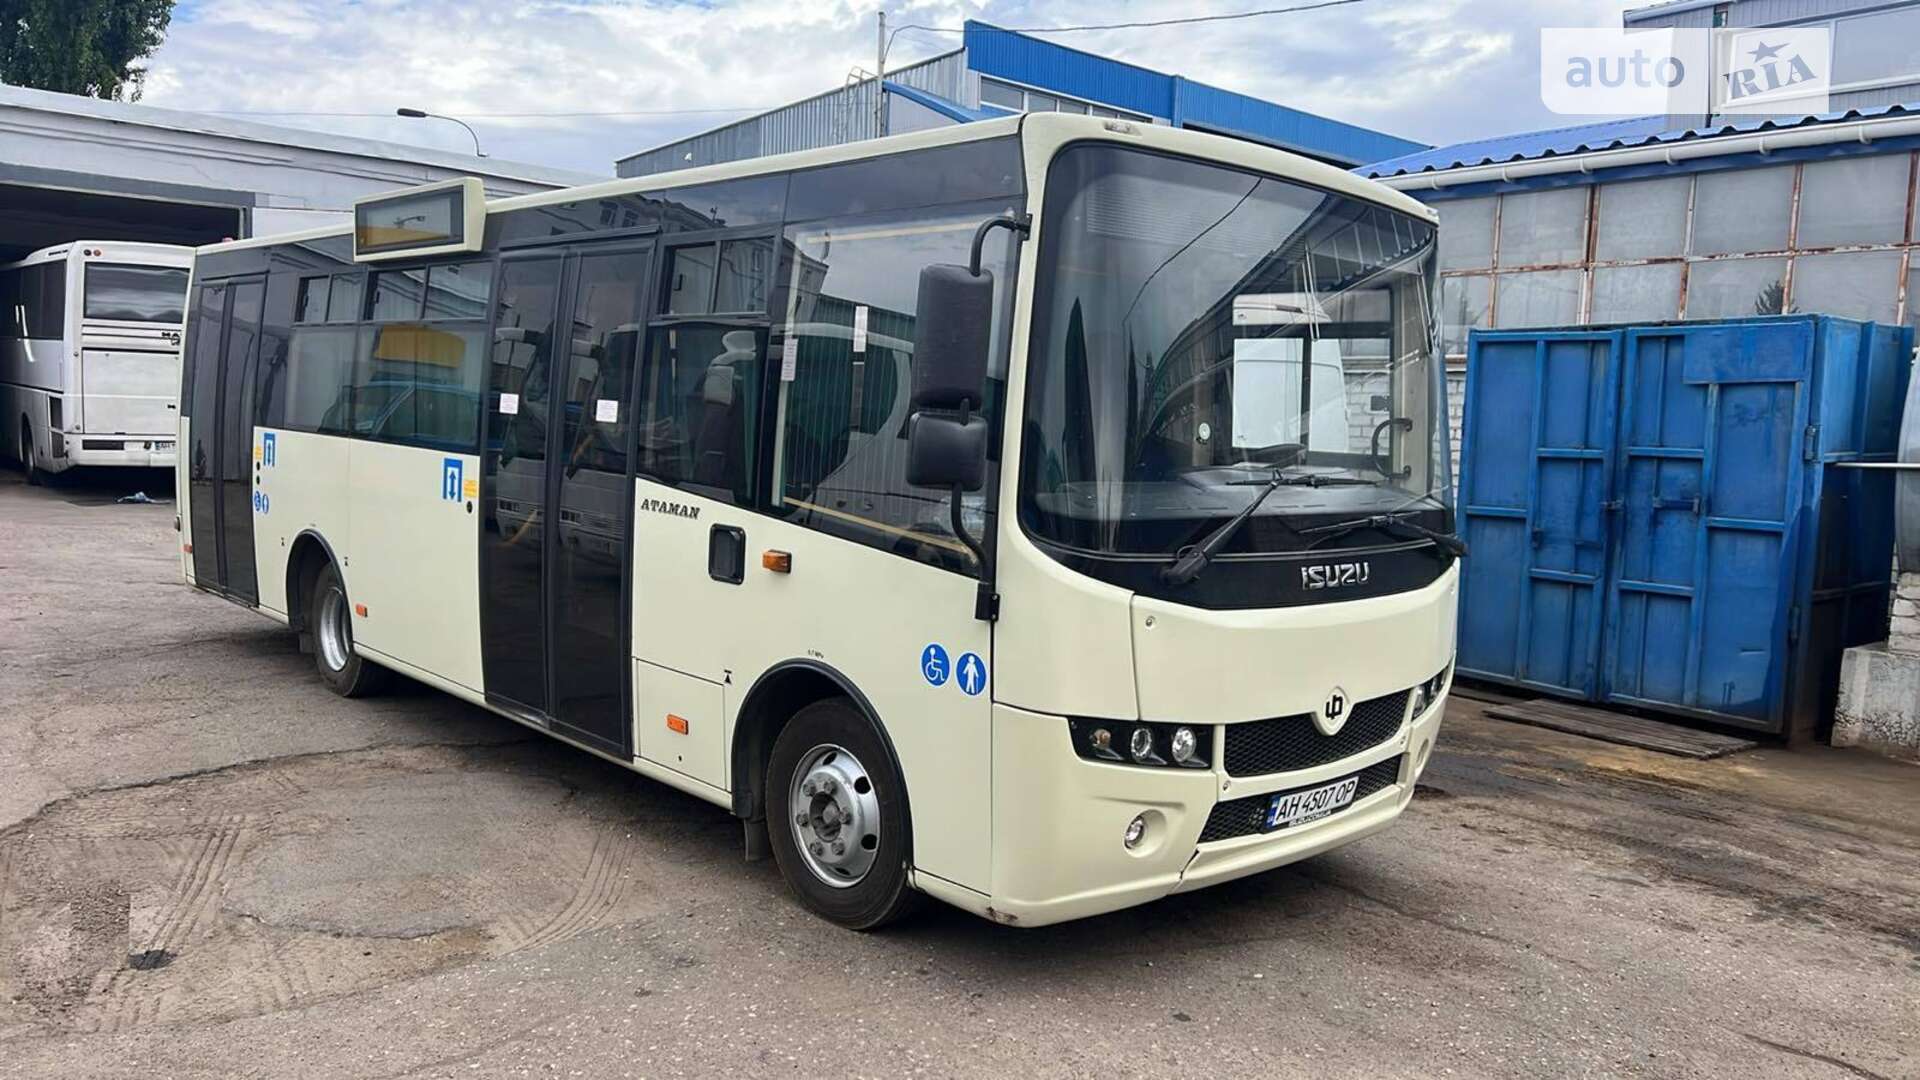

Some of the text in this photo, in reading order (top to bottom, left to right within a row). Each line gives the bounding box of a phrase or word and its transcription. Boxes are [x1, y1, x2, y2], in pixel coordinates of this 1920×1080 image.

[640, 498, 700, 520] ATAMAN
[1301, 562, 1369, 591] ISUZU
[1276, 795, 1302, 821] AH
[1302, 786, 1336, 813] 4507
[1335, 780, 1355, 804] OP
